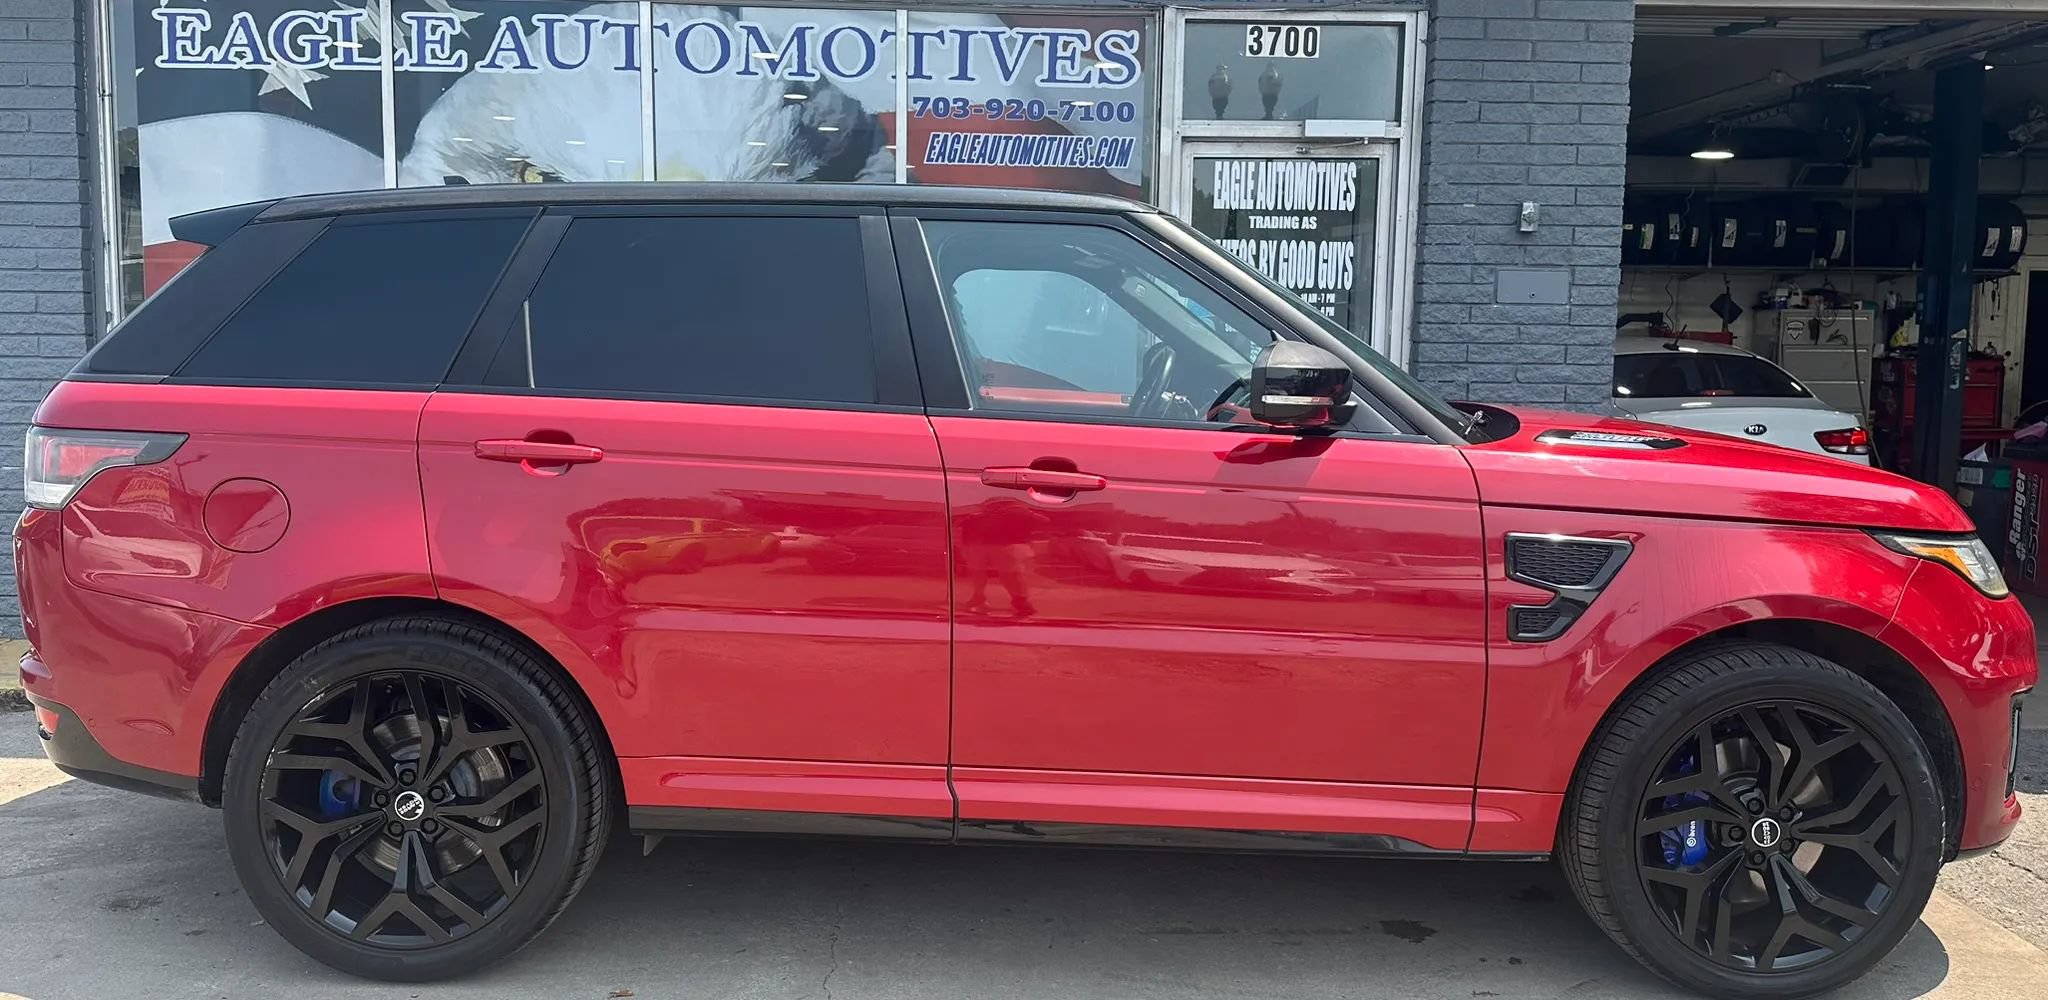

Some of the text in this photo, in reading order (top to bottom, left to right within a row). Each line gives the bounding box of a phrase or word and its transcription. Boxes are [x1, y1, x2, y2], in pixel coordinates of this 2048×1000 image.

[153, 9, 1140, 88] EAGLE AUTOMOTIVES
[1248, 25, 1318, 57] 3700
[912, 96, 1135, 122] 703-920-7100
[924, 132, 1135, 168] EAGLEAUTOMOTIVES.COM
[1213, 160, 1357, 212] EAGLE AUTOMOTIVES
[1249, 216, 1317, 230] TRADING AS
[1259, 239, 1278, 281] BY
[1278, 240, 1316, 290] GOOD
[1318, 241, 1354, 290] GUYS
[1325, 306, 1335, 316] PM
[1326, 293, 1335, 303] PM
[2009, 467, 2027, 546] Ranger
